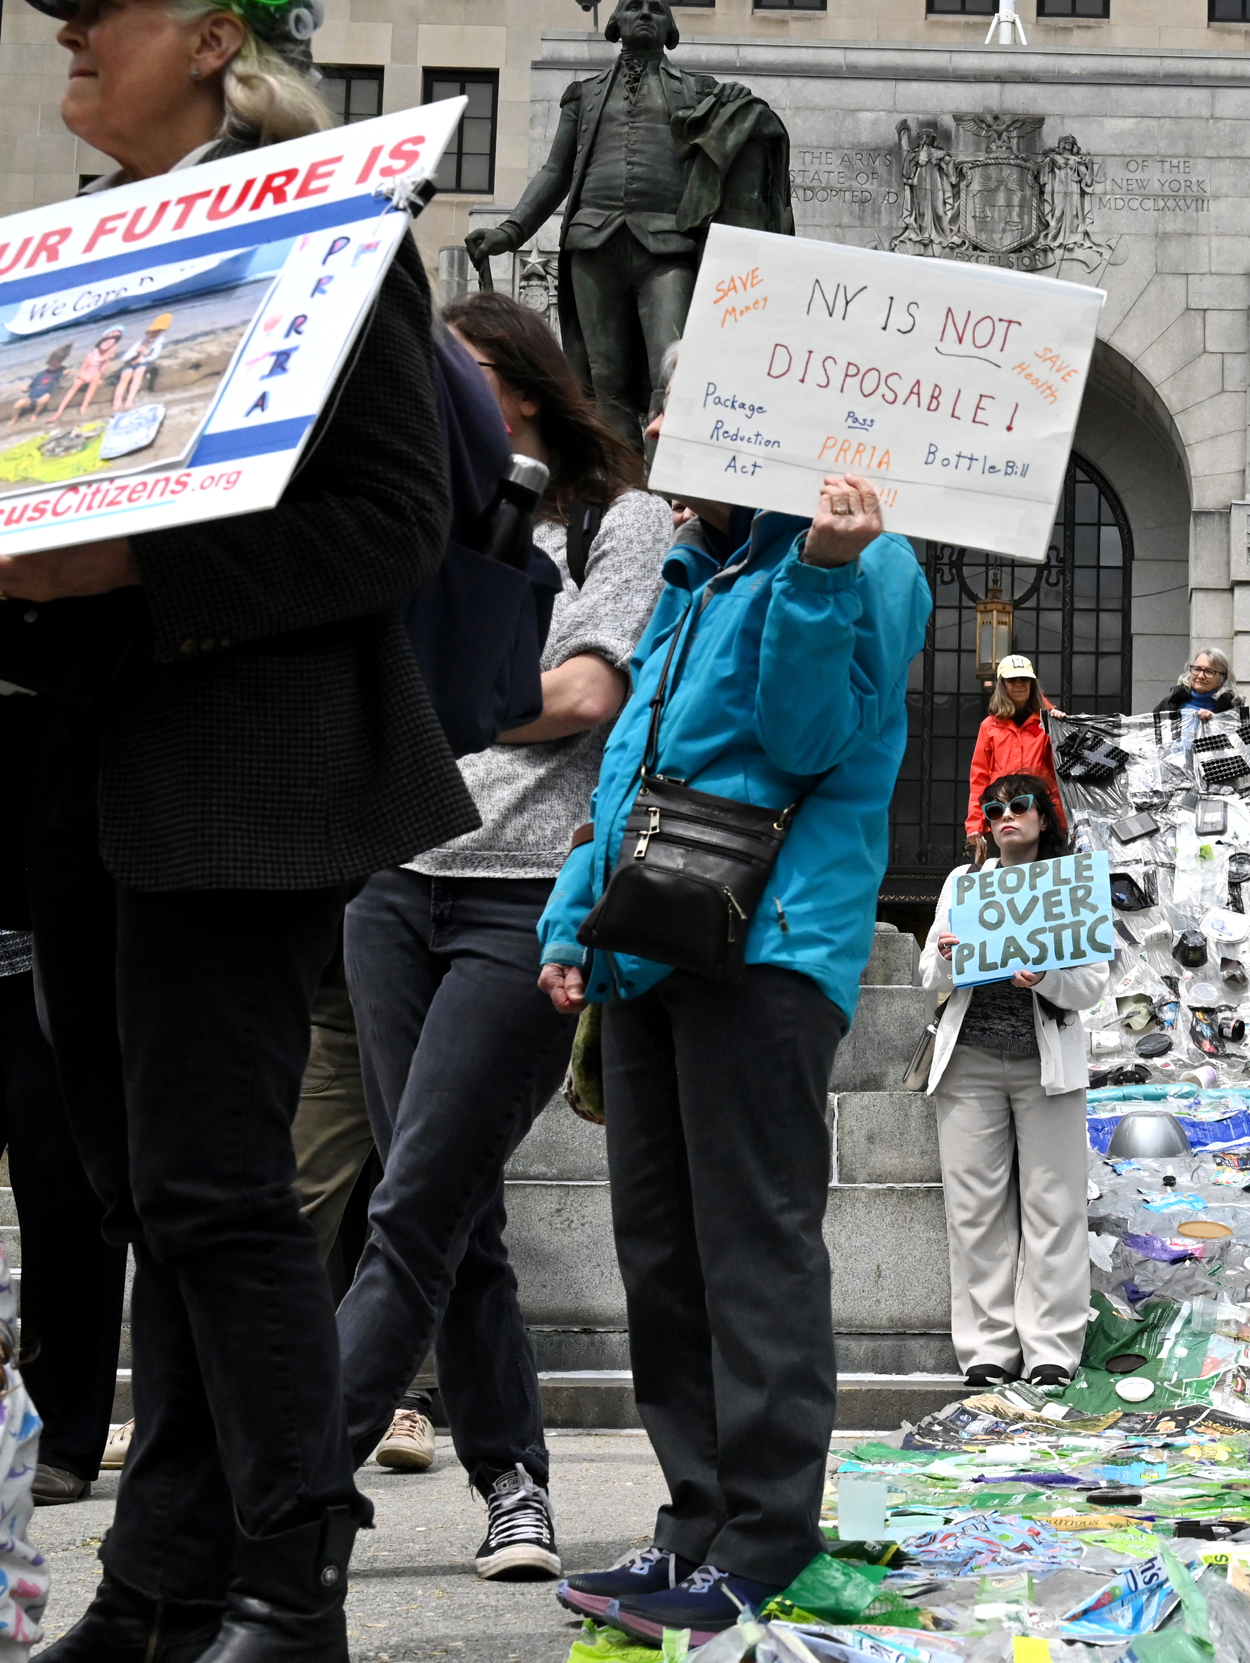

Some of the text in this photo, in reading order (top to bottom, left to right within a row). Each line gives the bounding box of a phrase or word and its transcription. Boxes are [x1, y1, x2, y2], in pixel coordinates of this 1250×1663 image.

[799, 151, 892, 167] THE ARMS
[1126, 159, 1190, 174] OF THE
[790, 170, 878, 185] STATE OF
[1112, 178, 1207, 193] NEW YORK
[82, 155, 344, 255] FUTURE
[355, 135, 426, 186] IS
[791, 188, 872, 203] ADOPTED
[1098, 197, 1210, 212] MDCCLXXVIII
[955, 252, 1044, 269] EXCELSIOR
[713, 267, 764, 305] SAVE
[29, 302, 66, 322] We
[721, 296, 768, 329] Money
[806, 279, 1021, 353] NY IS NOT
[1034, 347, 1079, 383] SAVE
[767, 343, 1019, 432] DISPOSABLE!
[1011, 361, 1058, 405] Health
[703, 382, 767, 419] Package
[710, 419, 781, 449] Reduction
[845, 411, 875, 427] Pass
[724, 454, 763, 476] Act
[817, 436, 891, 471] PRRIA
[924, 443, 1030, 478] Bottle Bill
[956, 853, 1094, 906] PEOPLE
[979, 884, 1099, 931] OVER
[955, 914, 1112, 976] PLASTIC
